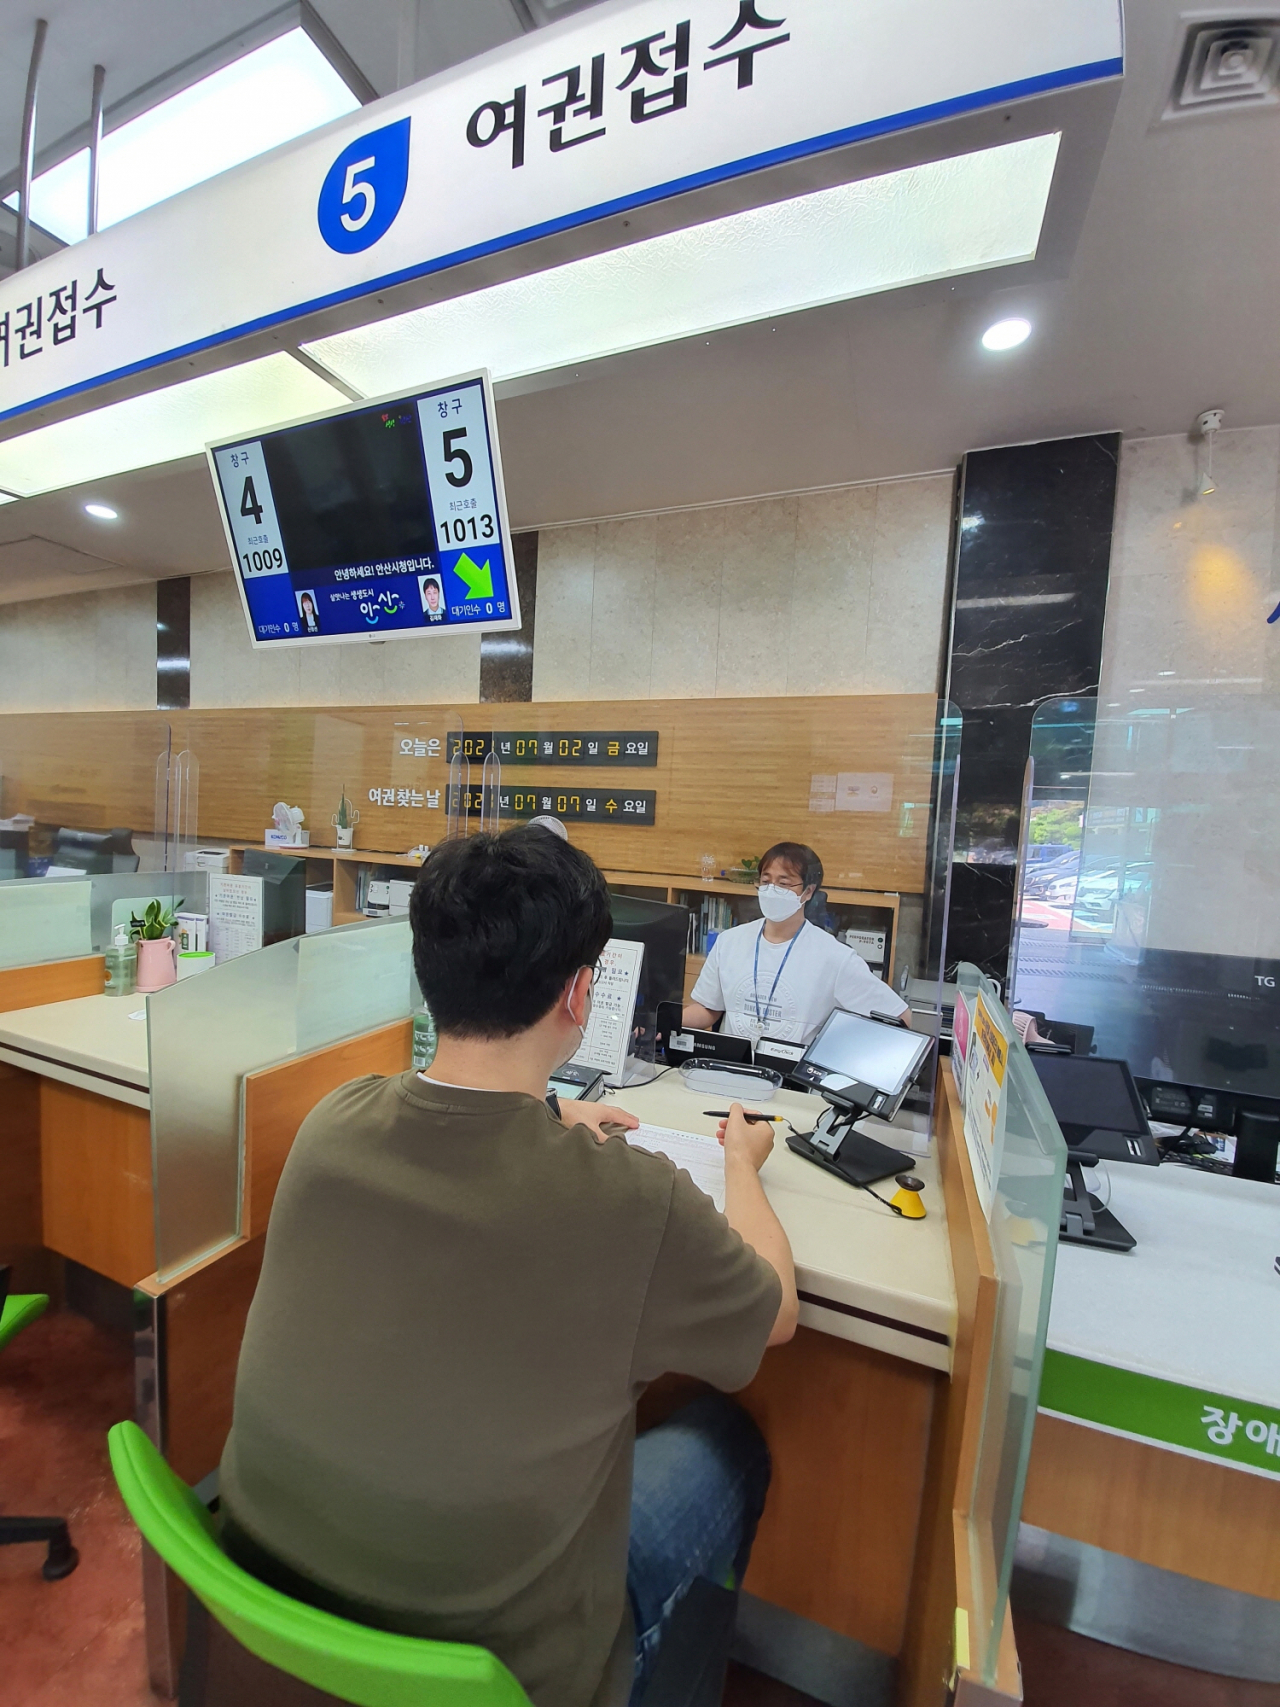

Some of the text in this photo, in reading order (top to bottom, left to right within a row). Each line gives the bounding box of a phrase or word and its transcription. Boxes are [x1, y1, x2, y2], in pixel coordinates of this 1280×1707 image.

[340, 0, 790, 232] 5 여권접수
[437, 398, 463, 418] 창구
[230, 452, 250, 468] 창구
[443, 426, 473, 488] 5
[240, 475, 263, 525] 4
[449, 498, 478, 512] 최근호출
[439, 514, 495, 544] 1013
[242, 548, 283, 573] 1009
[334, 557, 435, 581] 안녕하세요! 안산시청입니다.
[350, 588, 374, 601] 생생도시
[451, 601, 506, 617] 대기인수 0 명
[284, 622, 290, 633] 0
[399, 737, 441, 757] 오늘은
[500, 741, 511, 754] 년
[516, 739, 538, 756] 07
[543, 741, 553, 755] 월
[559, 739, 582, 756] 02
[587, 741, 598, 755] 일
[607, 741, 620, 756] 금
[625, 741, 648, 755] 요일
[368, 788, 395, 808] 여권
[397, 788, 424, 808] 찾는
[426, 789, 441, 809] 날
[499, 795, 509, 808] 년
[514, 794, 536, 810] 07
[541, 796, 552, 810] 월
[557, 795, 580, 812] 07
[585, 798, 596, 812] 일
[605, 798, 618, 814] 수
[622, 800, 646, 814] 요일
[1254, 975, 1276, 988] TG
[1200, 1404, 1280, 1458] 장애
